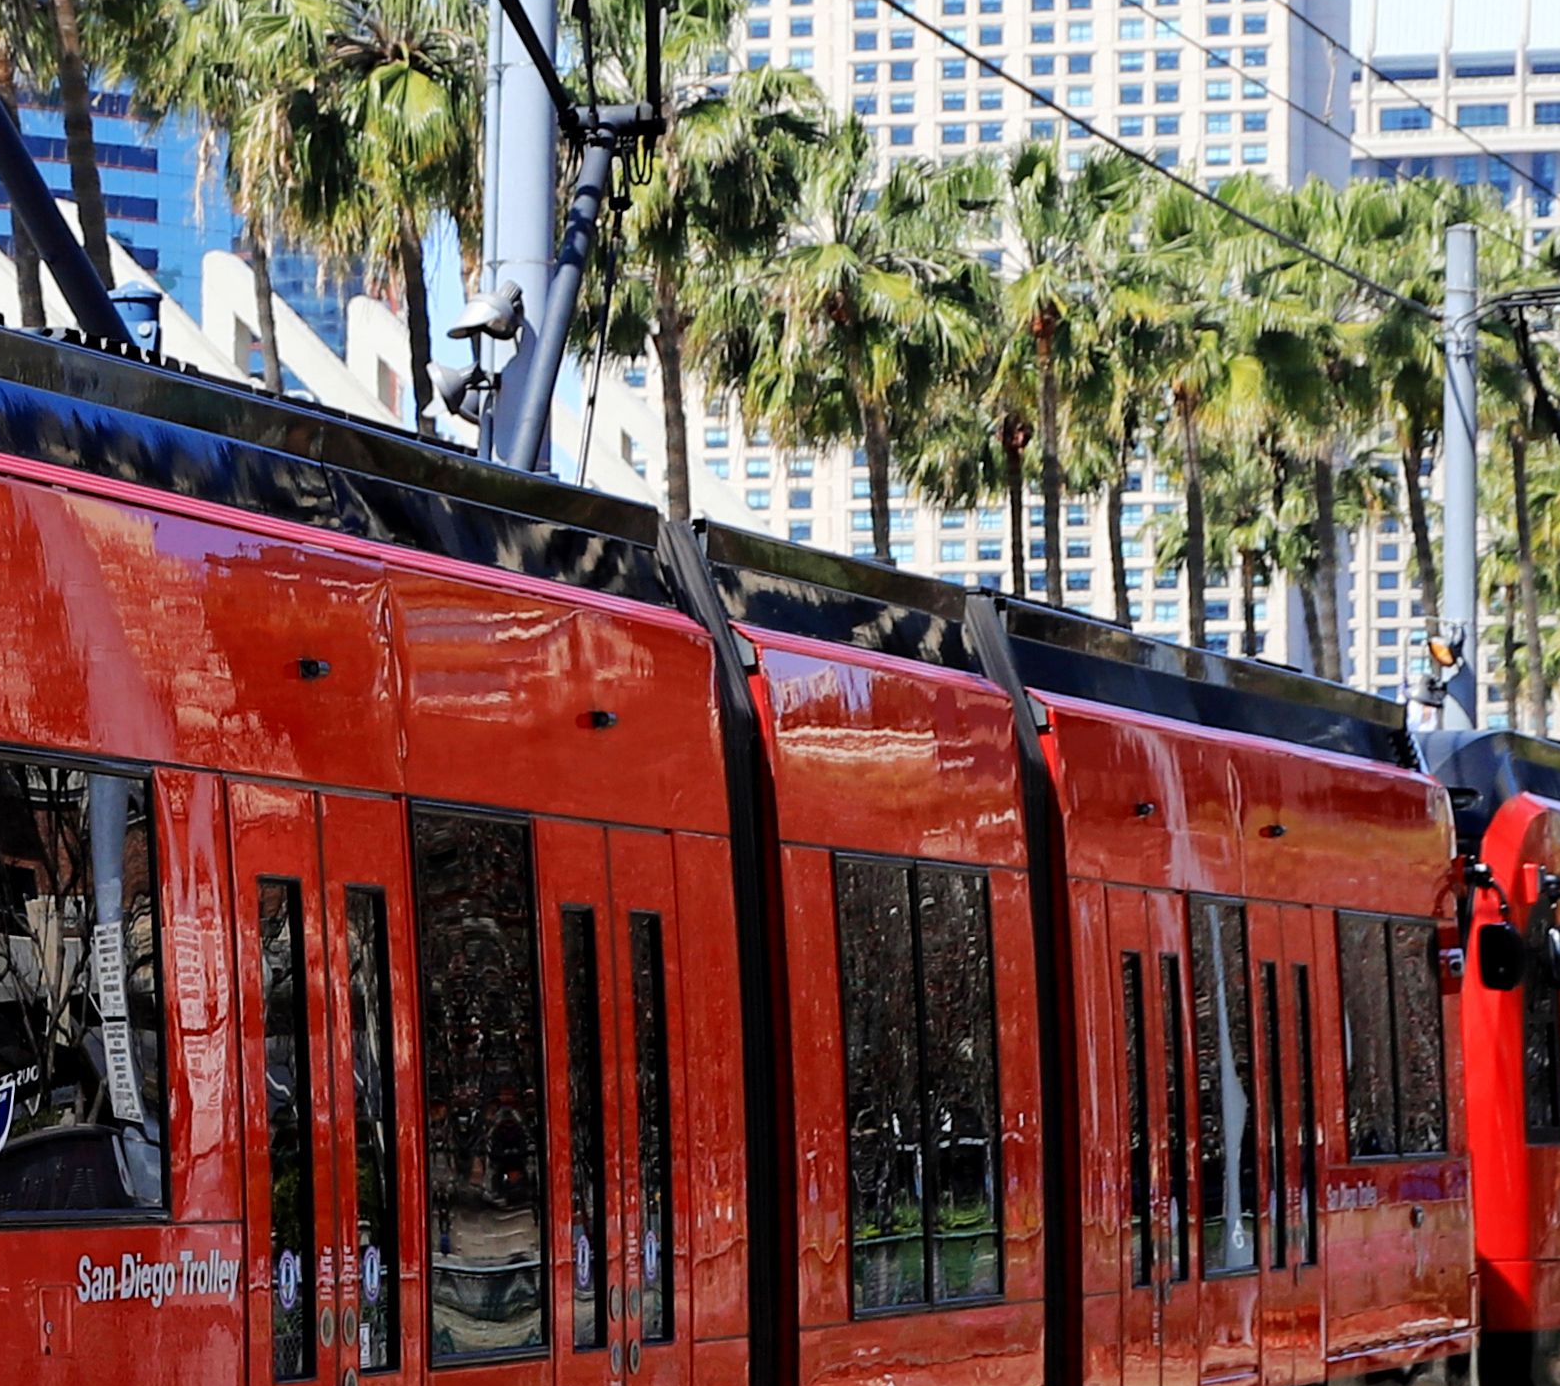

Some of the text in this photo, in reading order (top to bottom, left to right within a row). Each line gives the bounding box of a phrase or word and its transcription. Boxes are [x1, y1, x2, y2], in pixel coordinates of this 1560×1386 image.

[76, 1249, 240, 1308] San Diego Trolley
